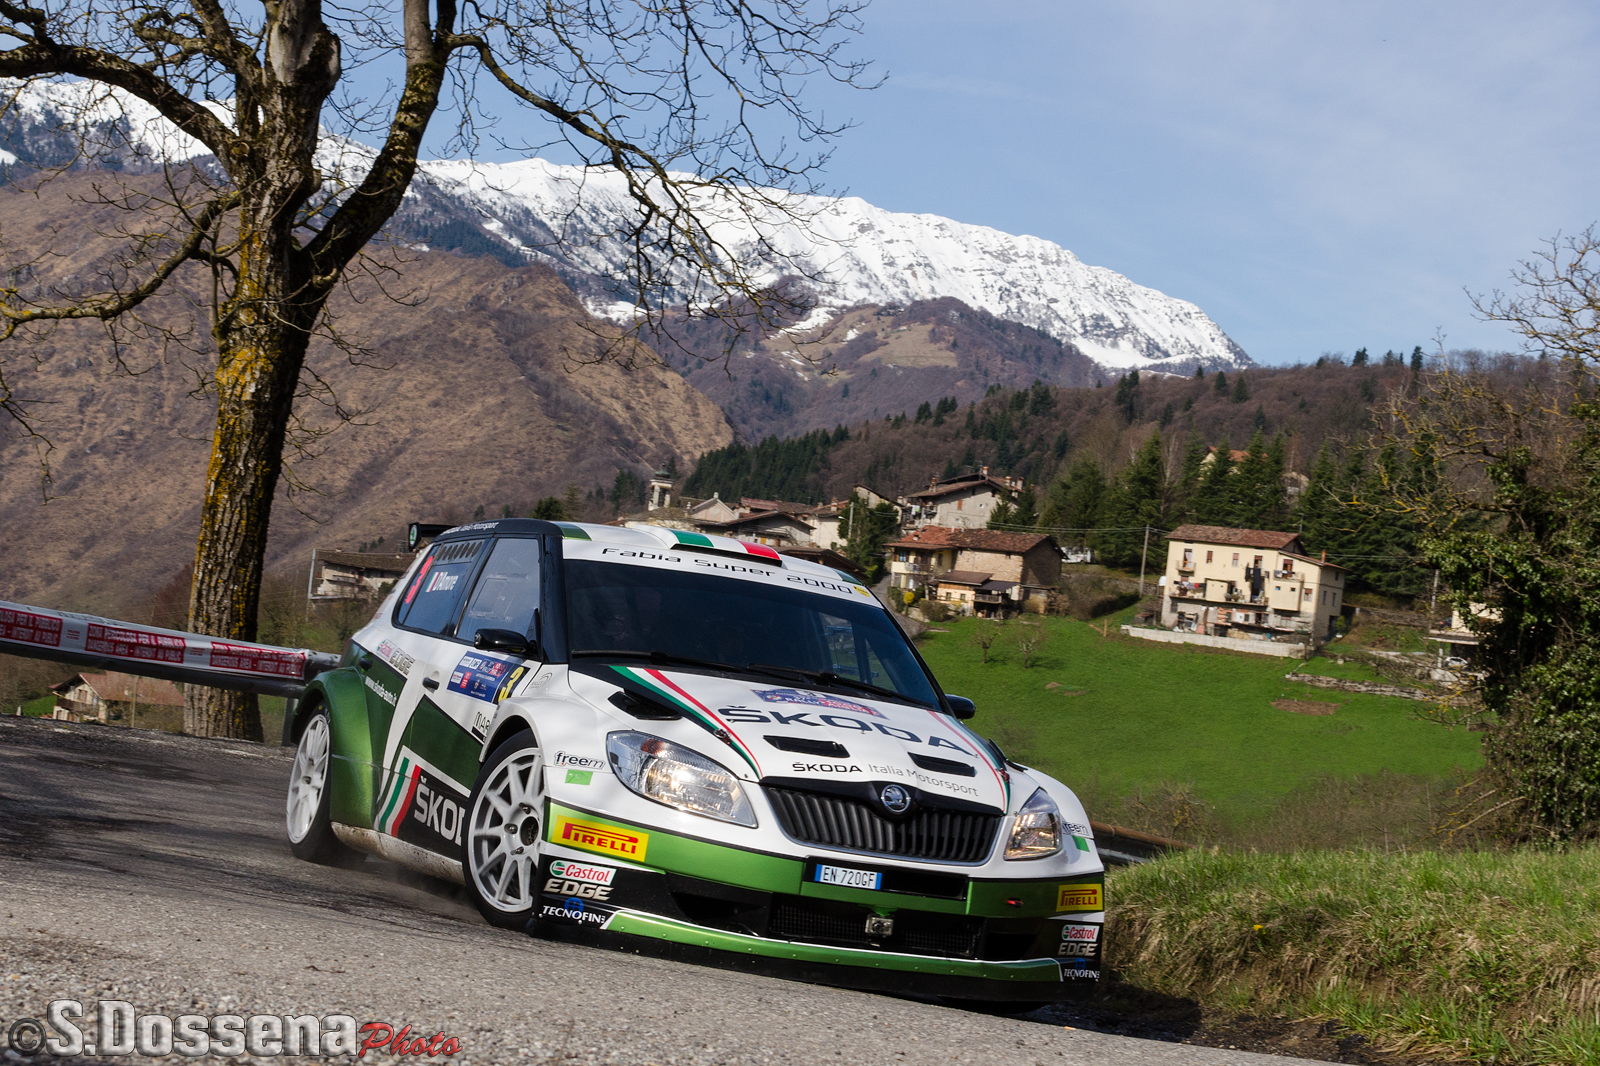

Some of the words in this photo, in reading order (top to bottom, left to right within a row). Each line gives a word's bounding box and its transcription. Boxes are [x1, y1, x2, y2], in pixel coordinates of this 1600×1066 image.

[602, 547, 681, 563] Fabia
[694, 558, 775, 577] Super
[786, 574, 853, 595] 2000
[389, 647, 416, 676] EDGE
[498, 666, 525, 703] 3
[717, 705, 979, 758] ŠKODA
[555, 751, 605, 770] freem
[792, 761, 863, 773] ŠKODA
[868, 763, 904, 776] Italia
[906, 767, 980, 797] Motorsport
[561, 822, 639, 854] PIRELLI
[565, 864, 611, 883] Castrol
[822, 866, 838, 882] EN
[840, 869, 876, 887] 720GF
[543, 878, 615, 901] EDGE
[1060, 888, 1098, 907] PIRELLI
[1068, 926, 1096, 940] Castrol
[1058, 942, 1099, 957] EDGE
